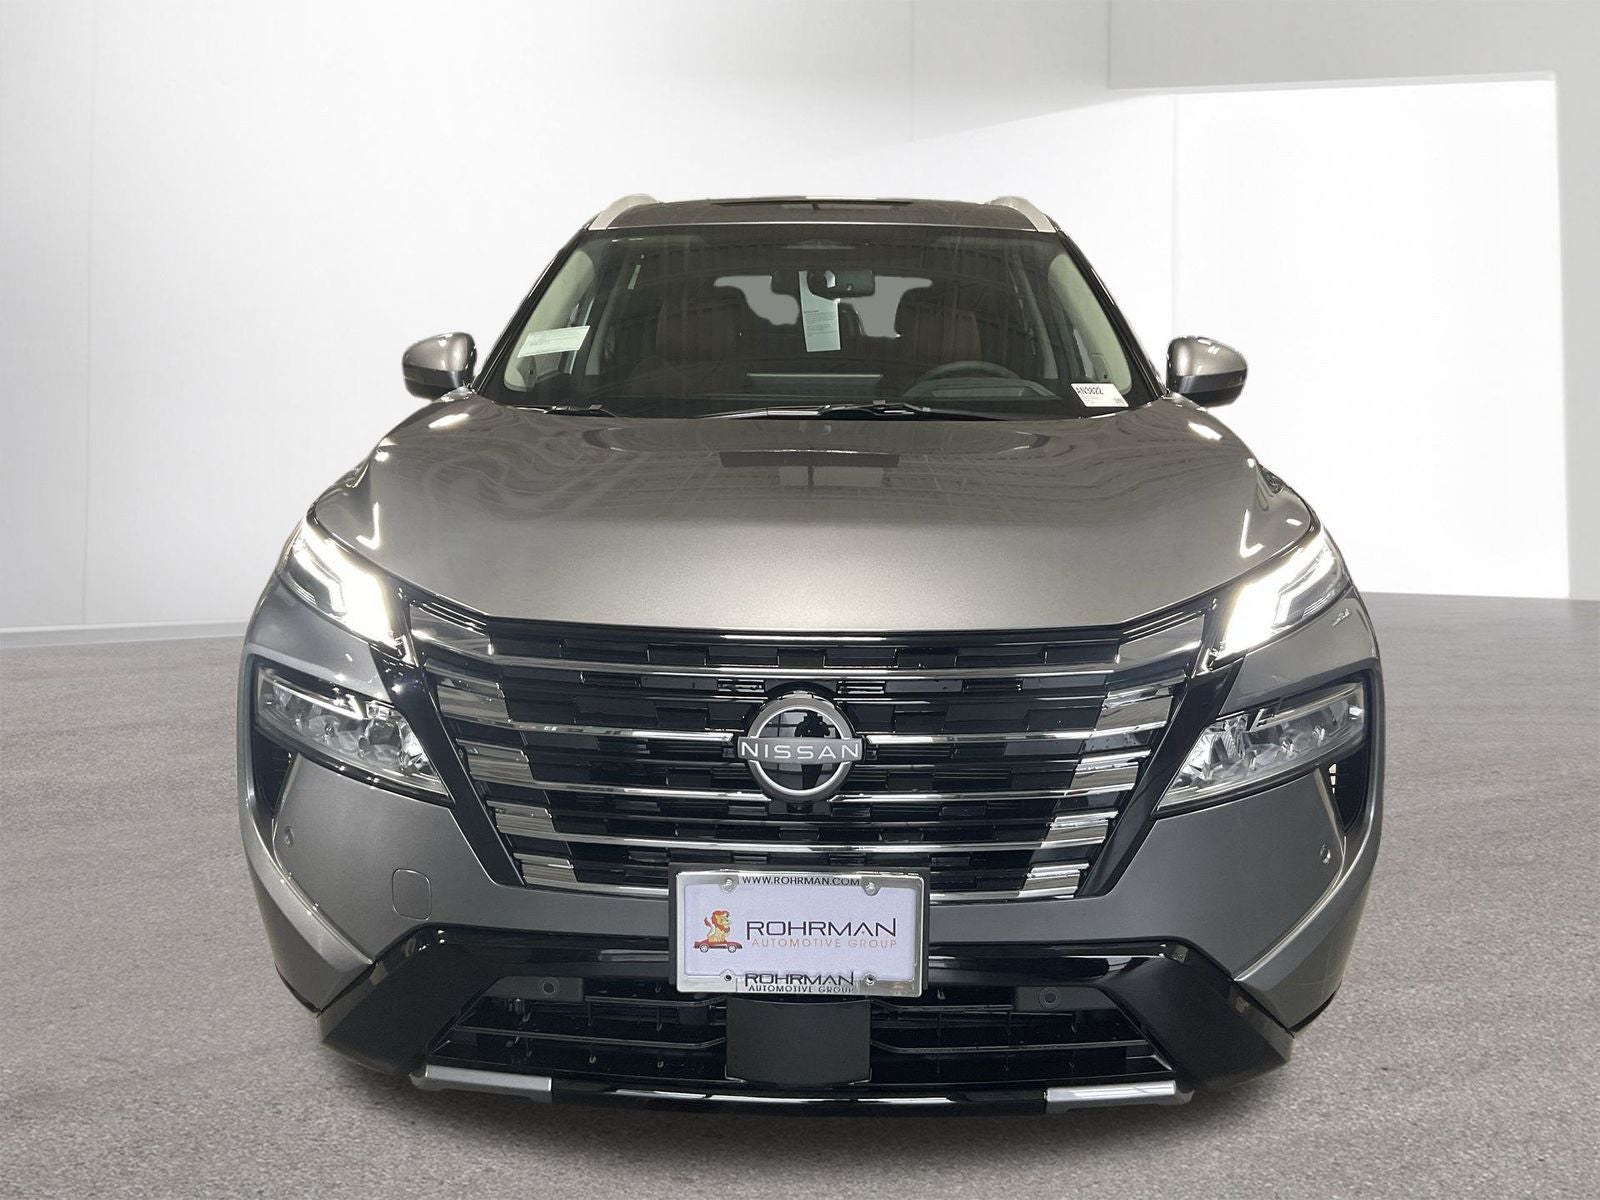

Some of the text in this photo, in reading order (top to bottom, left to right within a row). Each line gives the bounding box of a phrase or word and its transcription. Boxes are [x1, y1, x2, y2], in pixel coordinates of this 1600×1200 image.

[741, 741, 859, 759] NISSAN
[742, 876, 860, 886] WWW.ROHRMAN.COM
[746, 918, 896, 940] ROHRMAN
[752, 939, 897, 949] AUTOMOTIVE GROUP
[744, 971, 854, 987] ROHRMAN
[748, 984, 854, 993] AUTOMOTIVE GROUP
